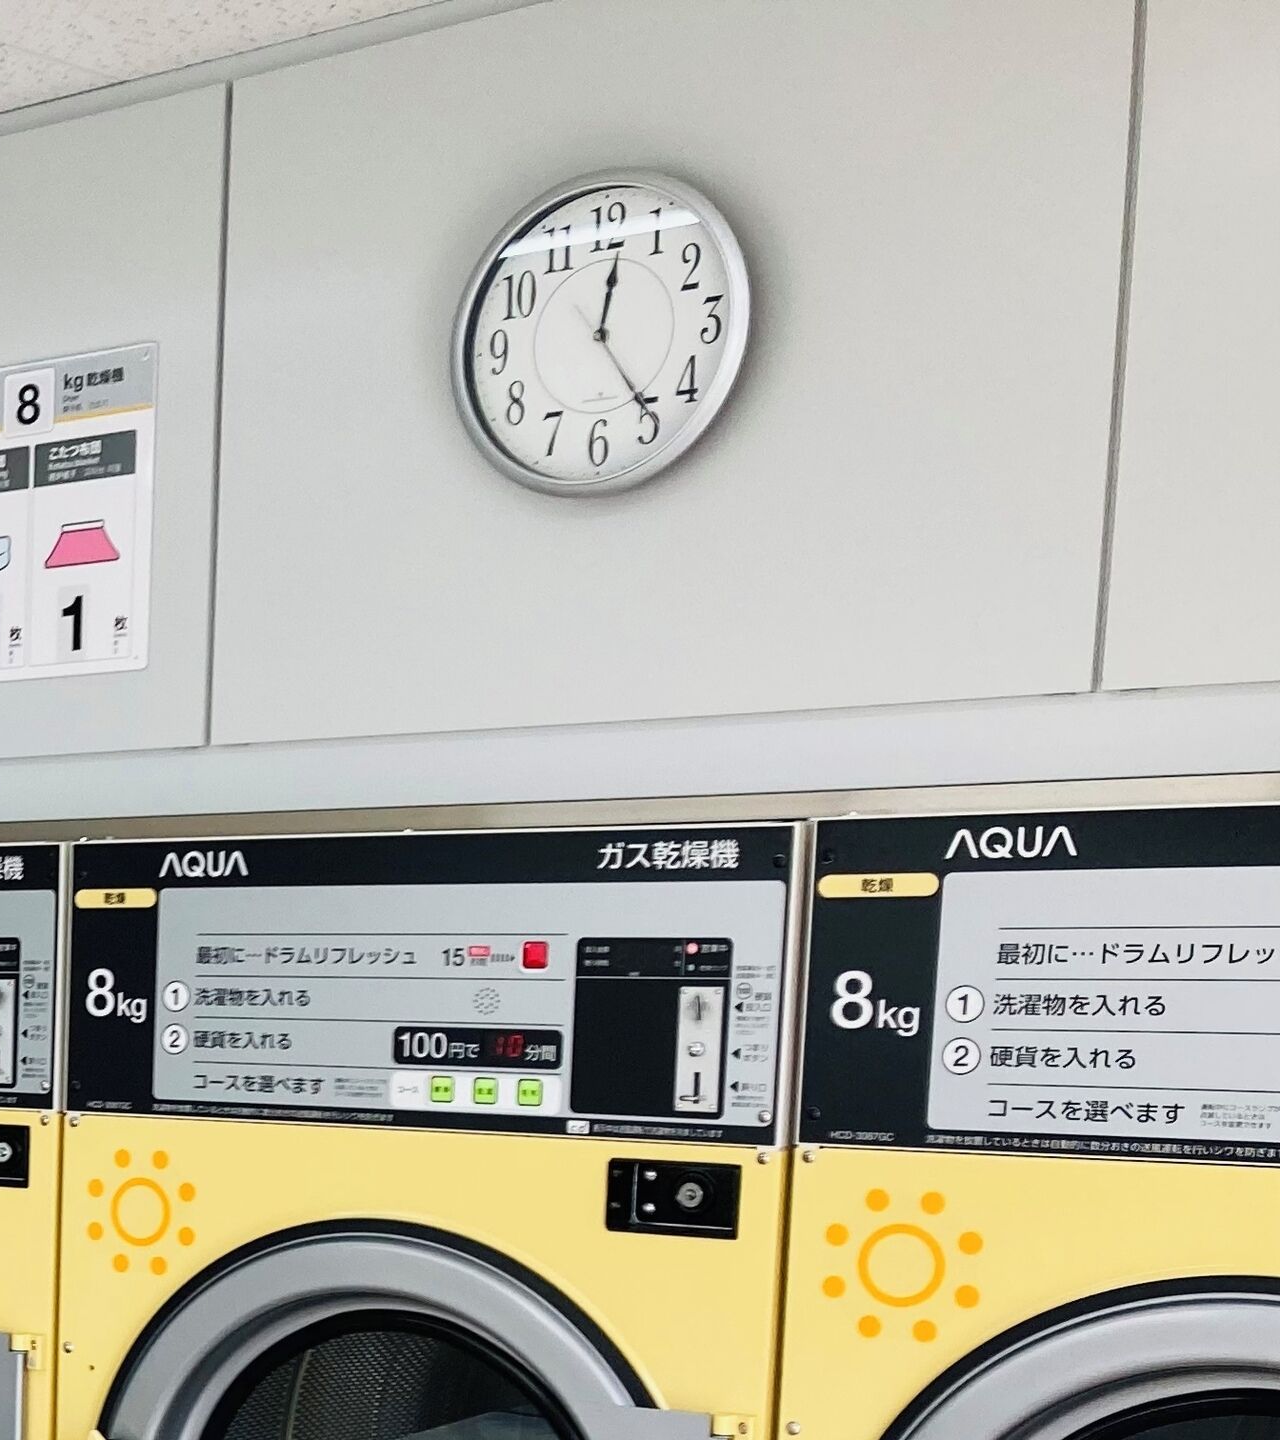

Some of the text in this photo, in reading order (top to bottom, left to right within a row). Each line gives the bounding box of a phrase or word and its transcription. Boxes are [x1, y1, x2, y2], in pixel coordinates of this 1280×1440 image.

[543, 224, 573, 274] 11
[649, 208, 663, 254] 1
[680, 243, 701, 291] 2
[502, 270, 536, 320] 10
[700, 294, 724, 344] 3
[490, 329, 508, 375] 9
[676, 355, 698, 403] 4
[17, 383, 40, 425] 8
[506, 381, 524, 425] 8
[637, 393, 659, 444] 5
[543, 410, 563, 456] 7
[589, 419, 608, 466] 6
[61, 595, 83, 651] 1
[159, 851, 249, 878] AQUA
[597, 839, 739, 869] ガス乾燥機
[945, 825, 1078, 860] AQUA
[861, 878, 894, 893] 乾燥
[442, 948, 465, 966] 15
[85, 968, 147, 1024] 8kg
[194, 988, 310, 1007] 洗濯物を入れる
[831, 970, 920, 1037] 8kg
[993, 994, 1166, 1017] 洗濯物を入れる
[193, 1031, 292, 1050] 硬貨を入れる
[524, 1044, 557, 1062] 分間
[990, 1047, 1137, 1070] 硬貨を入れる
[193, 1074, 324, 1095] コースを選べます
[988, 1100, 1185, 1125] コースを選べます
